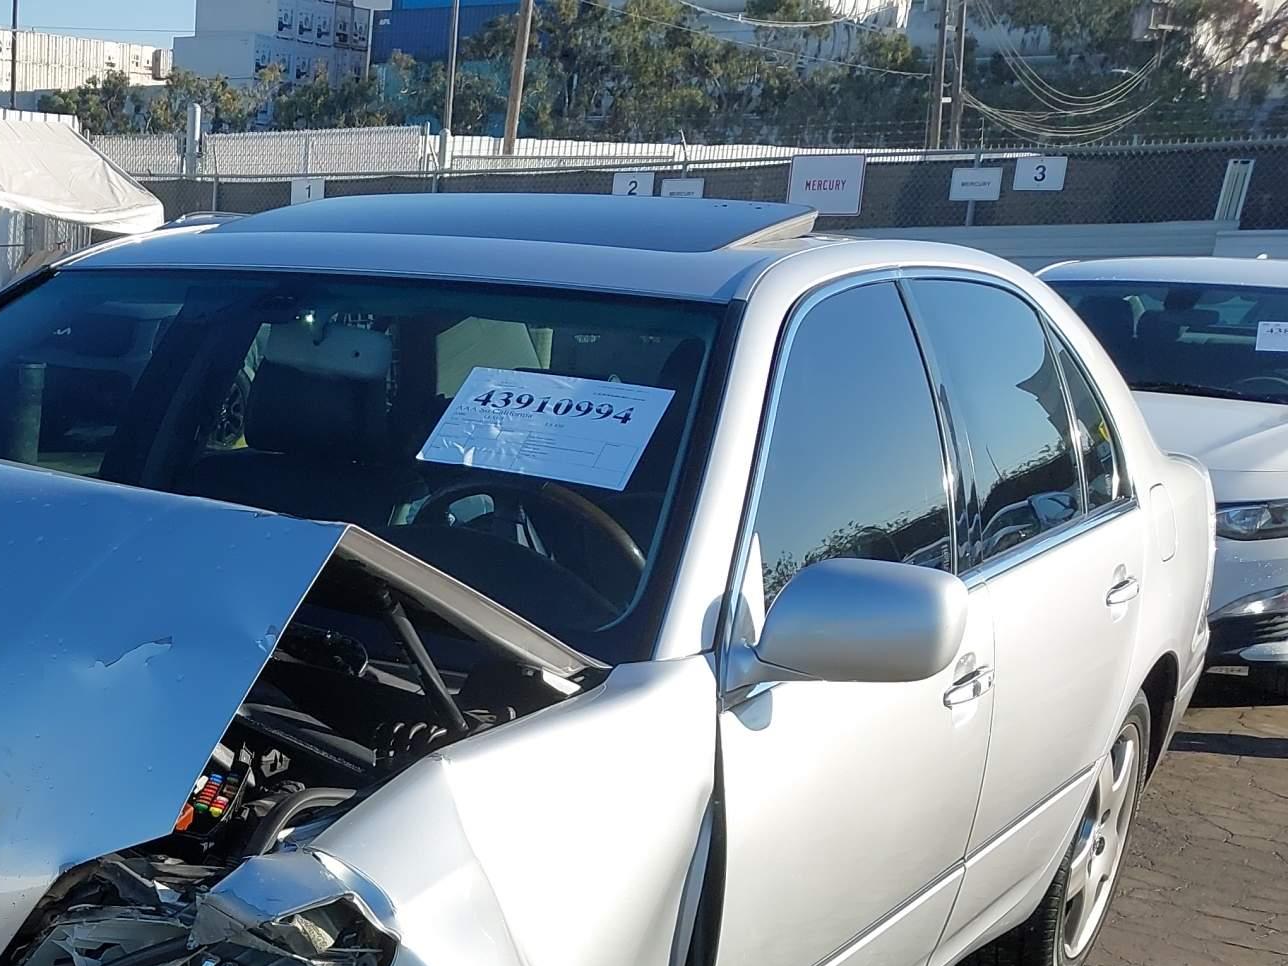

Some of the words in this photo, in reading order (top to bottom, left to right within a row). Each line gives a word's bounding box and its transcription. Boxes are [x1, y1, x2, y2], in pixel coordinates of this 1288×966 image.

[1033, 165, 1047, 182] 3
[305, 184, 312, 199] 1
[627, 180, 639, 196] 2
[804, 179, 848, 191] MERCURY
[473, 389, 634, 424] 43910994
